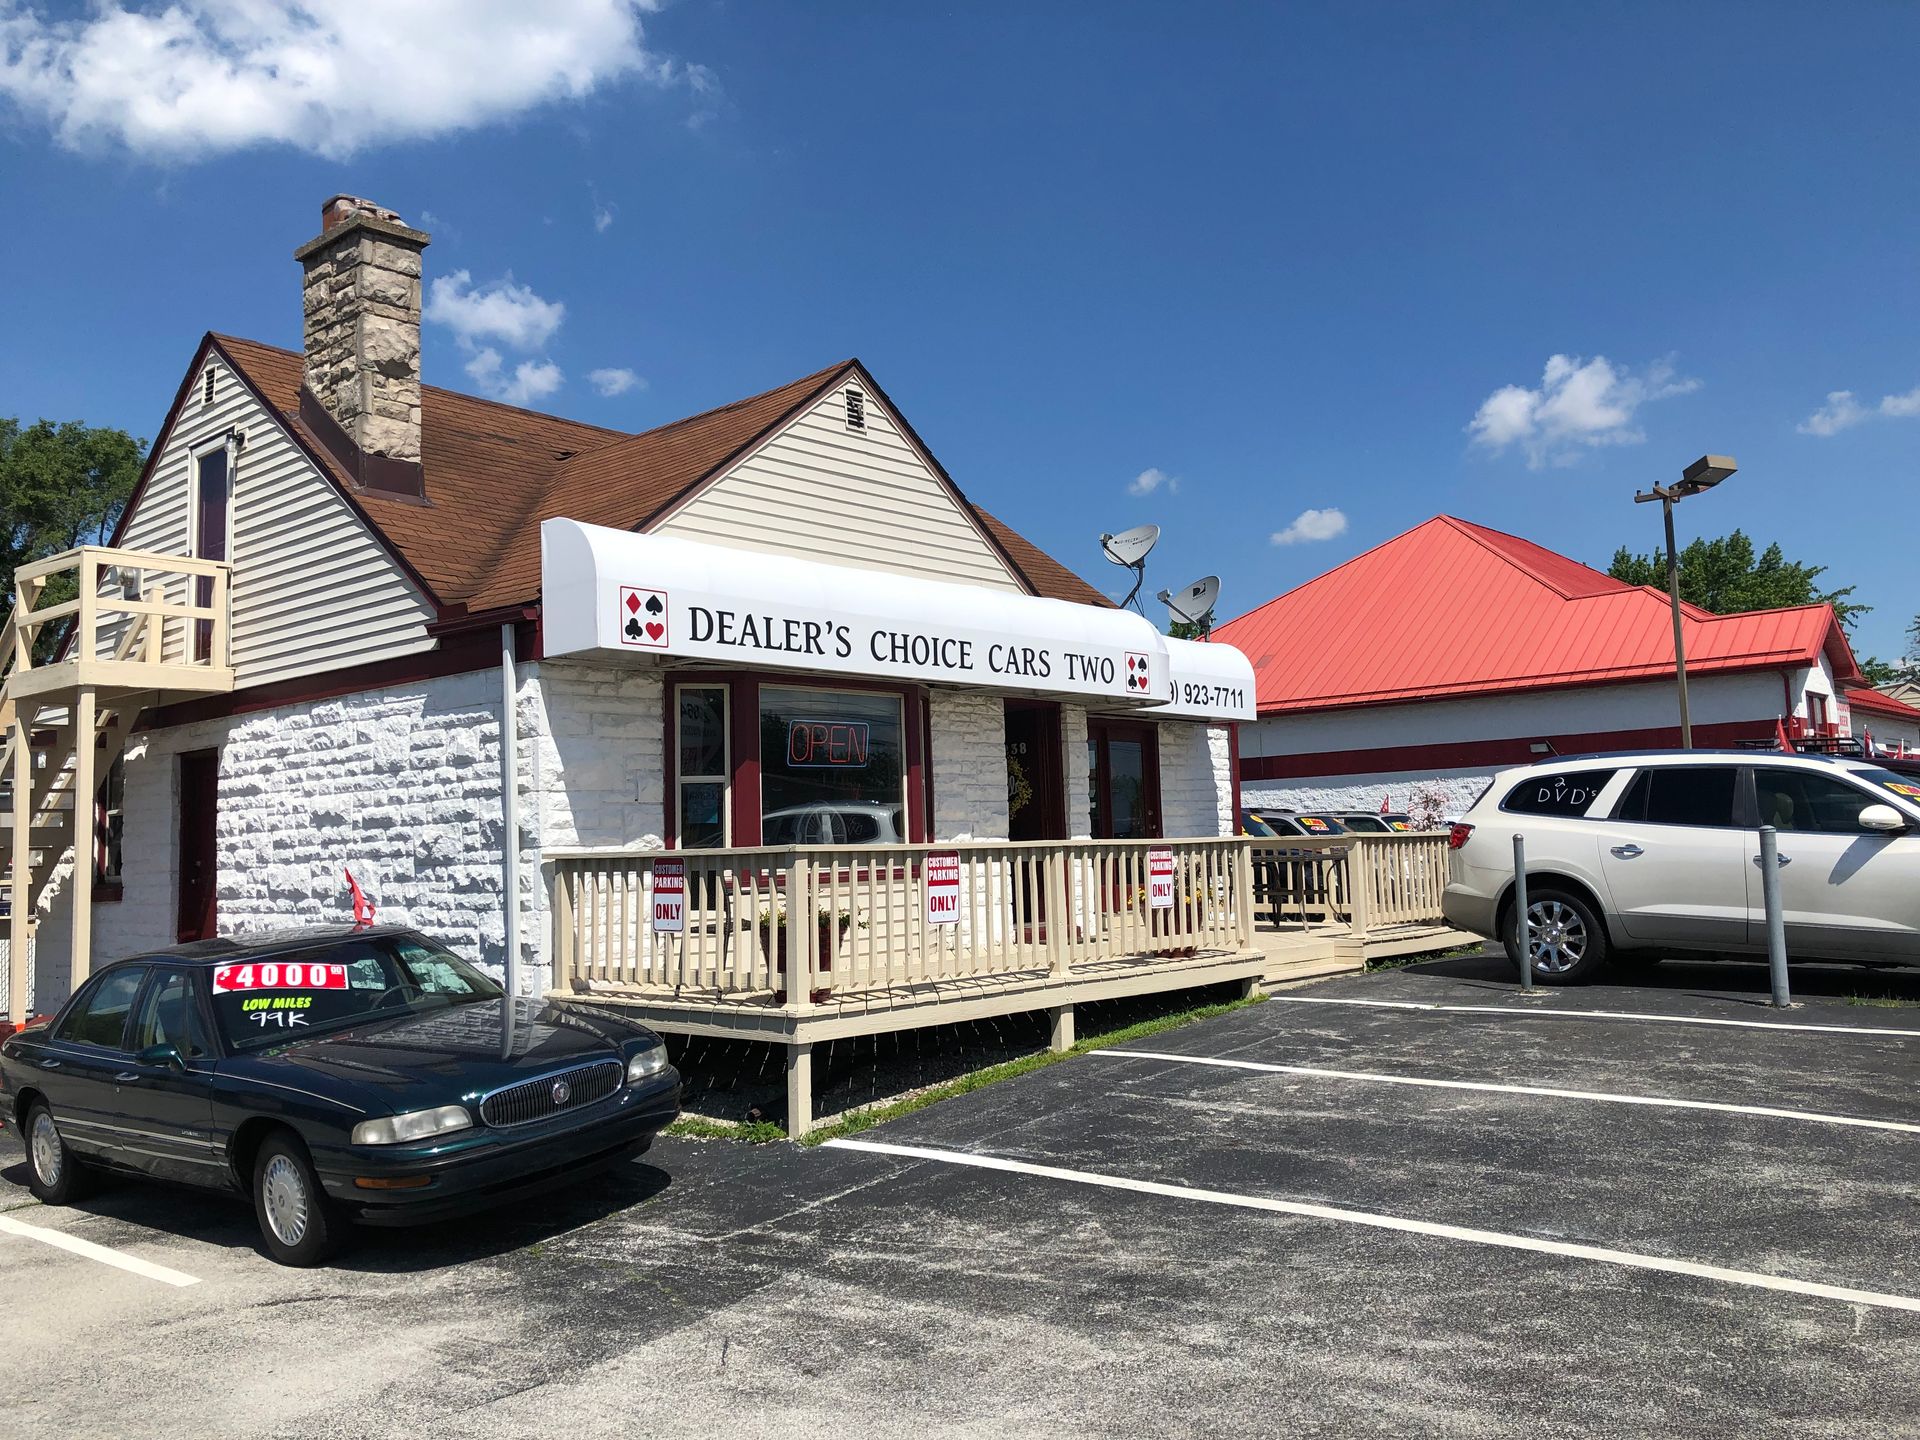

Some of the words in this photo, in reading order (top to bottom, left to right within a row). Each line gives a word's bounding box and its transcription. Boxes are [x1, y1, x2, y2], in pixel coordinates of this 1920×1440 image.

[688, 607, 852, 658] DEALER'S
[870, 630, 974, 670] CHOICE
[988, 644, 1051, 678] CARS
[1063, 653, 1115, 684] TWO
[1184, 683, 1243, 709] 923-7711
[791, 724, 866, 763] OPEN
[1554, 776, 1566, 787] 2
[1537, 787, 1598, 805] DVD's
[655, 864, 683, 875] CUSTOMER
[928, 857, 958, 868] CUSTOMER
[1151, 861, 1172, 871] PARKING
[928, 869, 958, 881] PARKING
[654, 876, 683, 889] PARKING
[1152, 883, 1171, 897] ONLY
[930, 895, 957, 912] ONLY
[655, 903, 681, 920] ONLY
[242, 999, 271, 1011] LOW
[272, 997, 312, 1009] MILES
